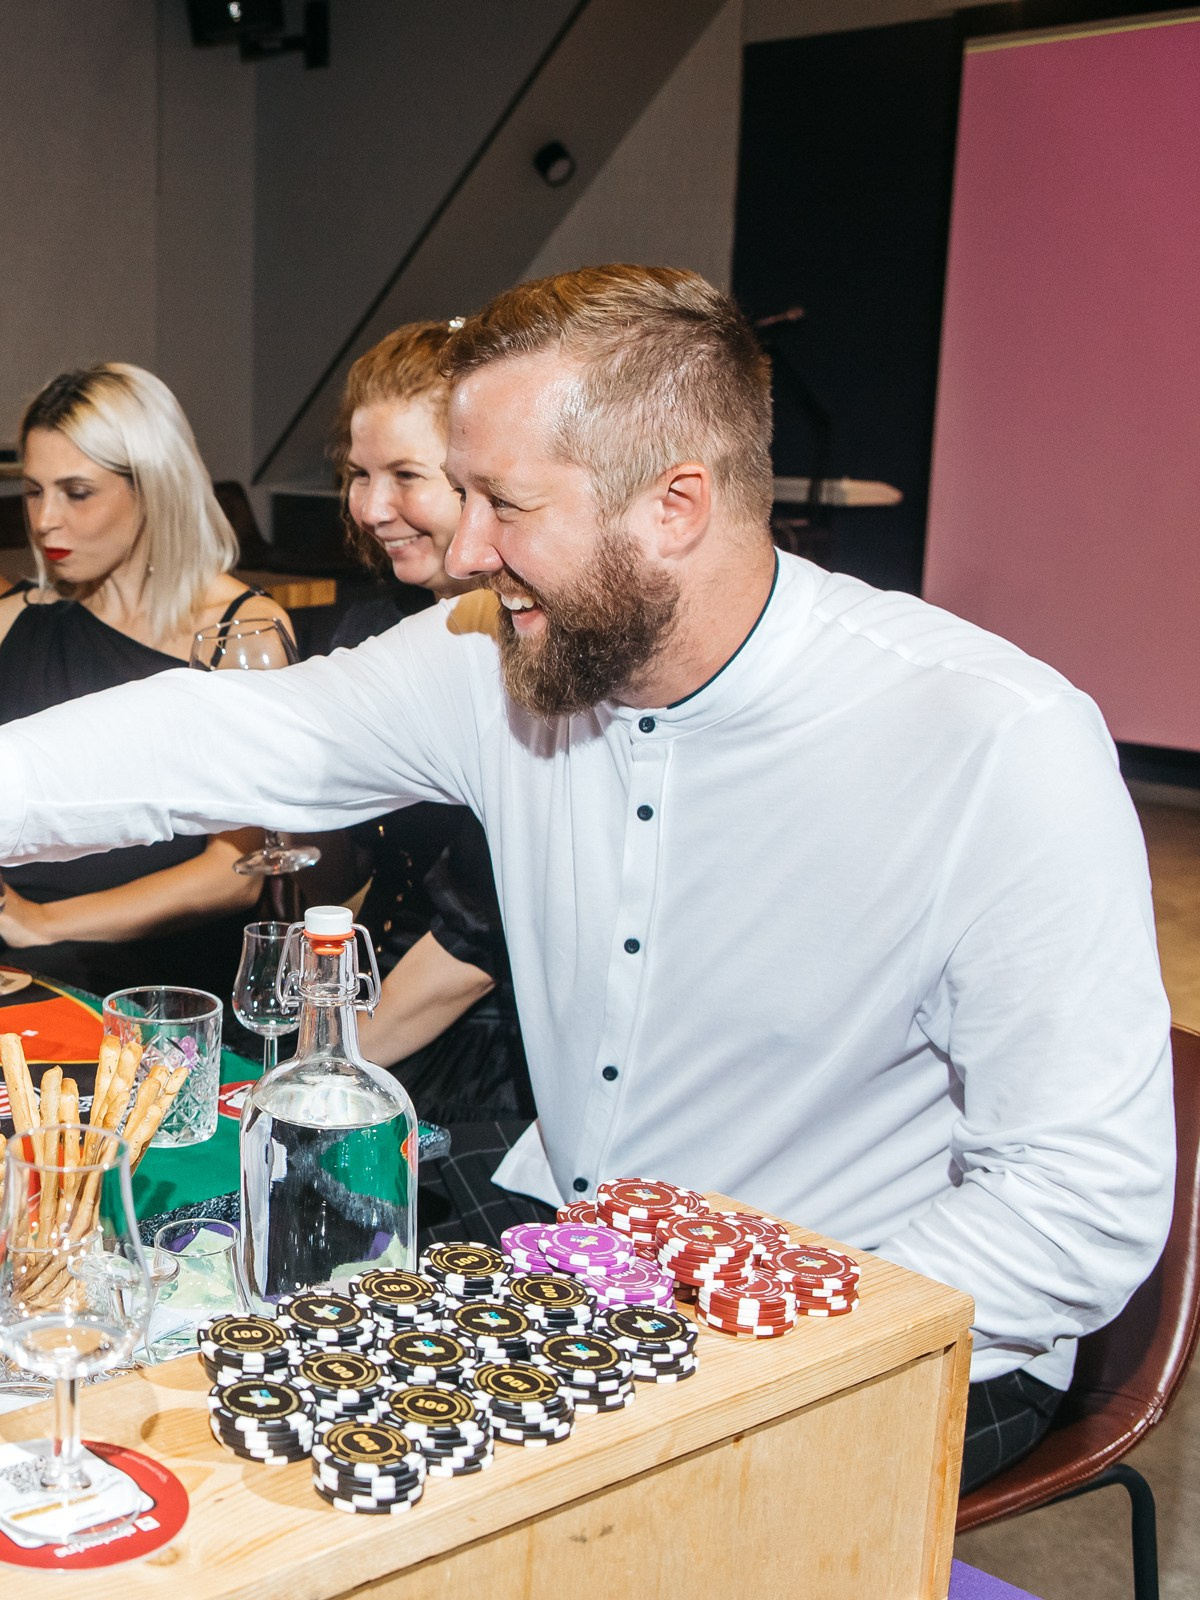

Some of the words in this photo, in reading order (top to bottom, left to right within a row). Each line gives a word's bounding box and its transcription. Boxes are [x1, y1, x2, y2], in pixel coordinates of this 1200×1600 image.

[453, 1255, 480, 1267] 100
[382, 1283, 412, 1293] 100
[540, 1284, 559, 1299] 100
[232, 1329, 263, 1339] 100
[326, 1361, 355, 1379] 100
[500, 1374, 532, 1391] 100
[415, 1397, 450, 1413] 100
[352, 1433, 381, 1452] 100
